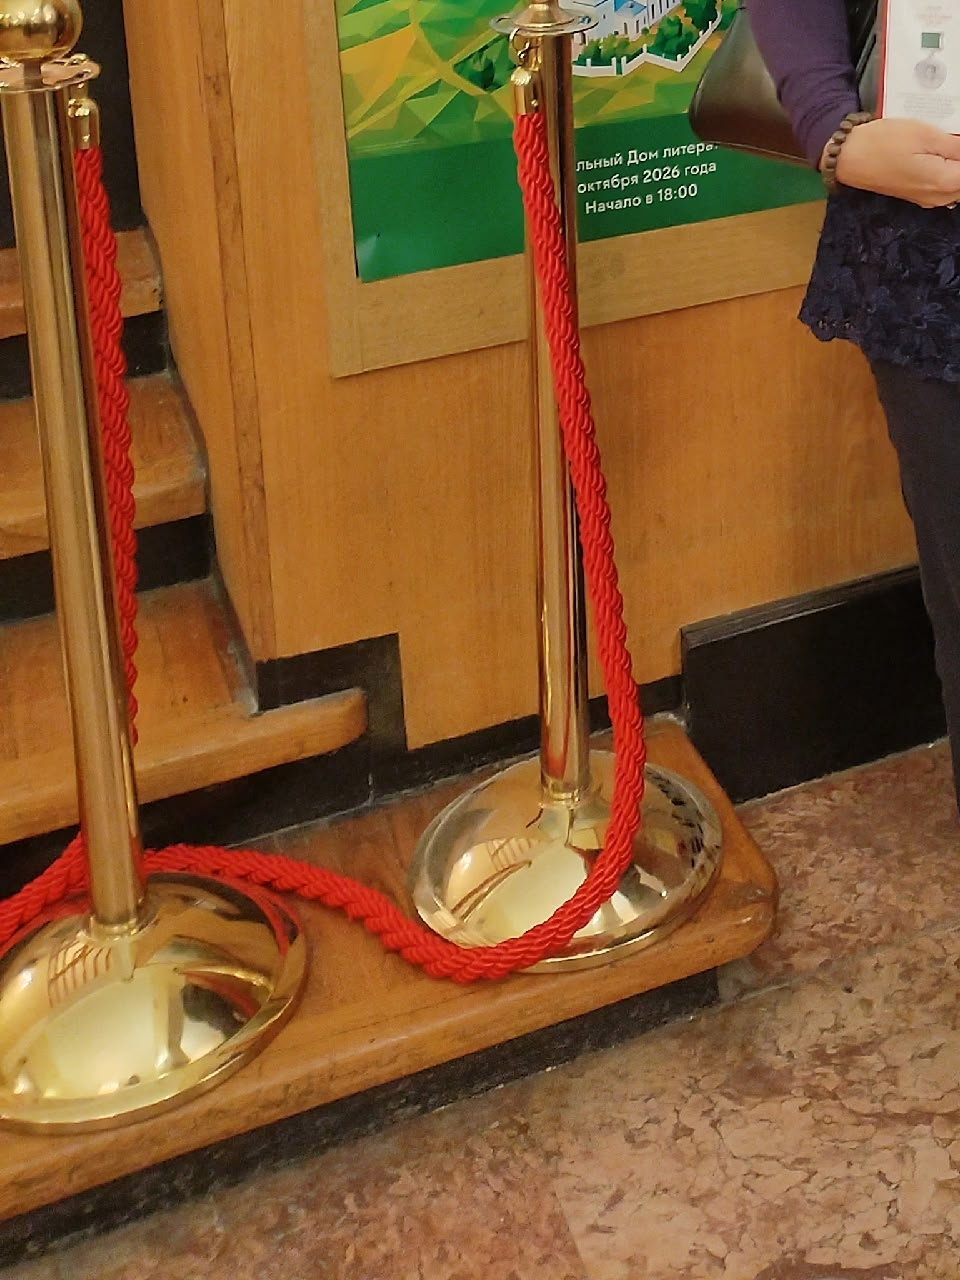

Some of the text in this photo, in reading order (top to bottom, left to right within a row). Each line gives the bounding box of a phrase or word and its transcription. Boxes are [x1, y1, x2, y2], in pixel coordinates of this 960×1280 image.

[626, 149, 658, 166] Дом
[577, 162, 716, 193] октября 2026 года
[585, 183, 697, 214] Начало в 18:00
